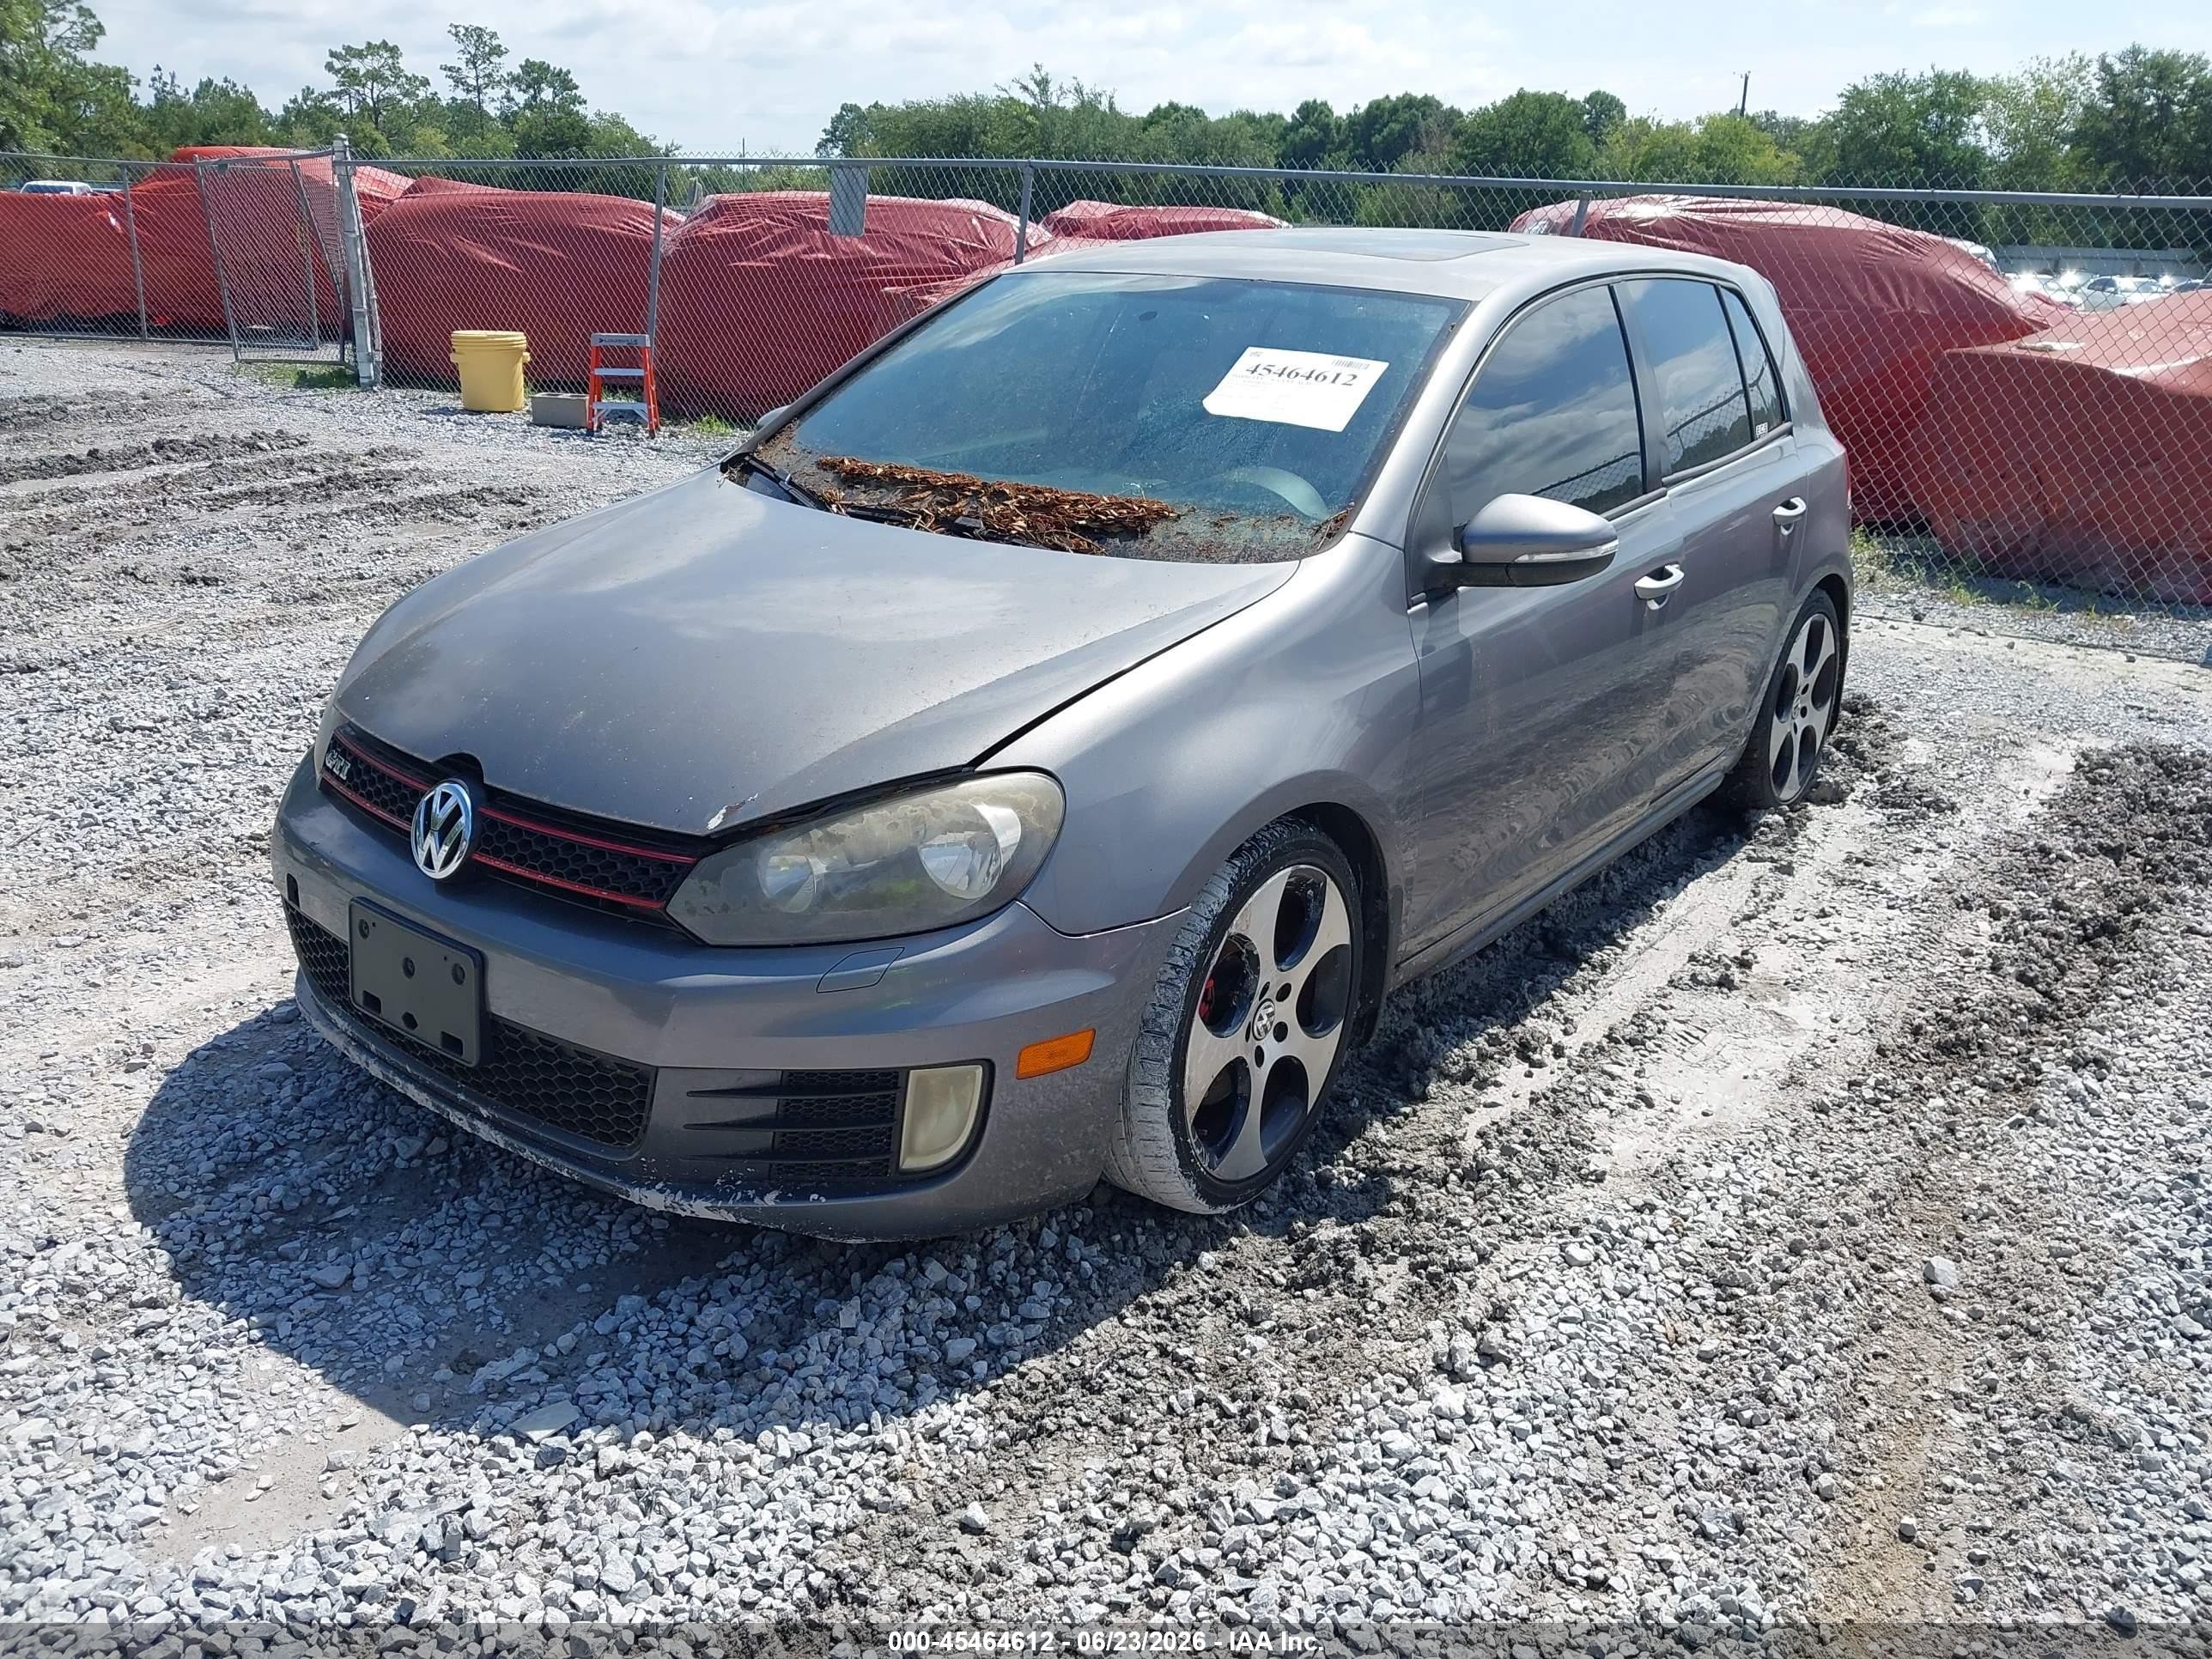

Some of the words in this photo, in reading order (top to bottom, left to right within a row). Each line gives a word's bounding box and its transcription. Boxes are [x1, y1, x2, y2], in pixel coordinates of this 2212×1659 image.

[1246, 363, 1358, 386] 45464612
[325, 749, 351, 781] GTI
[411, 782, 472, 879] VW
